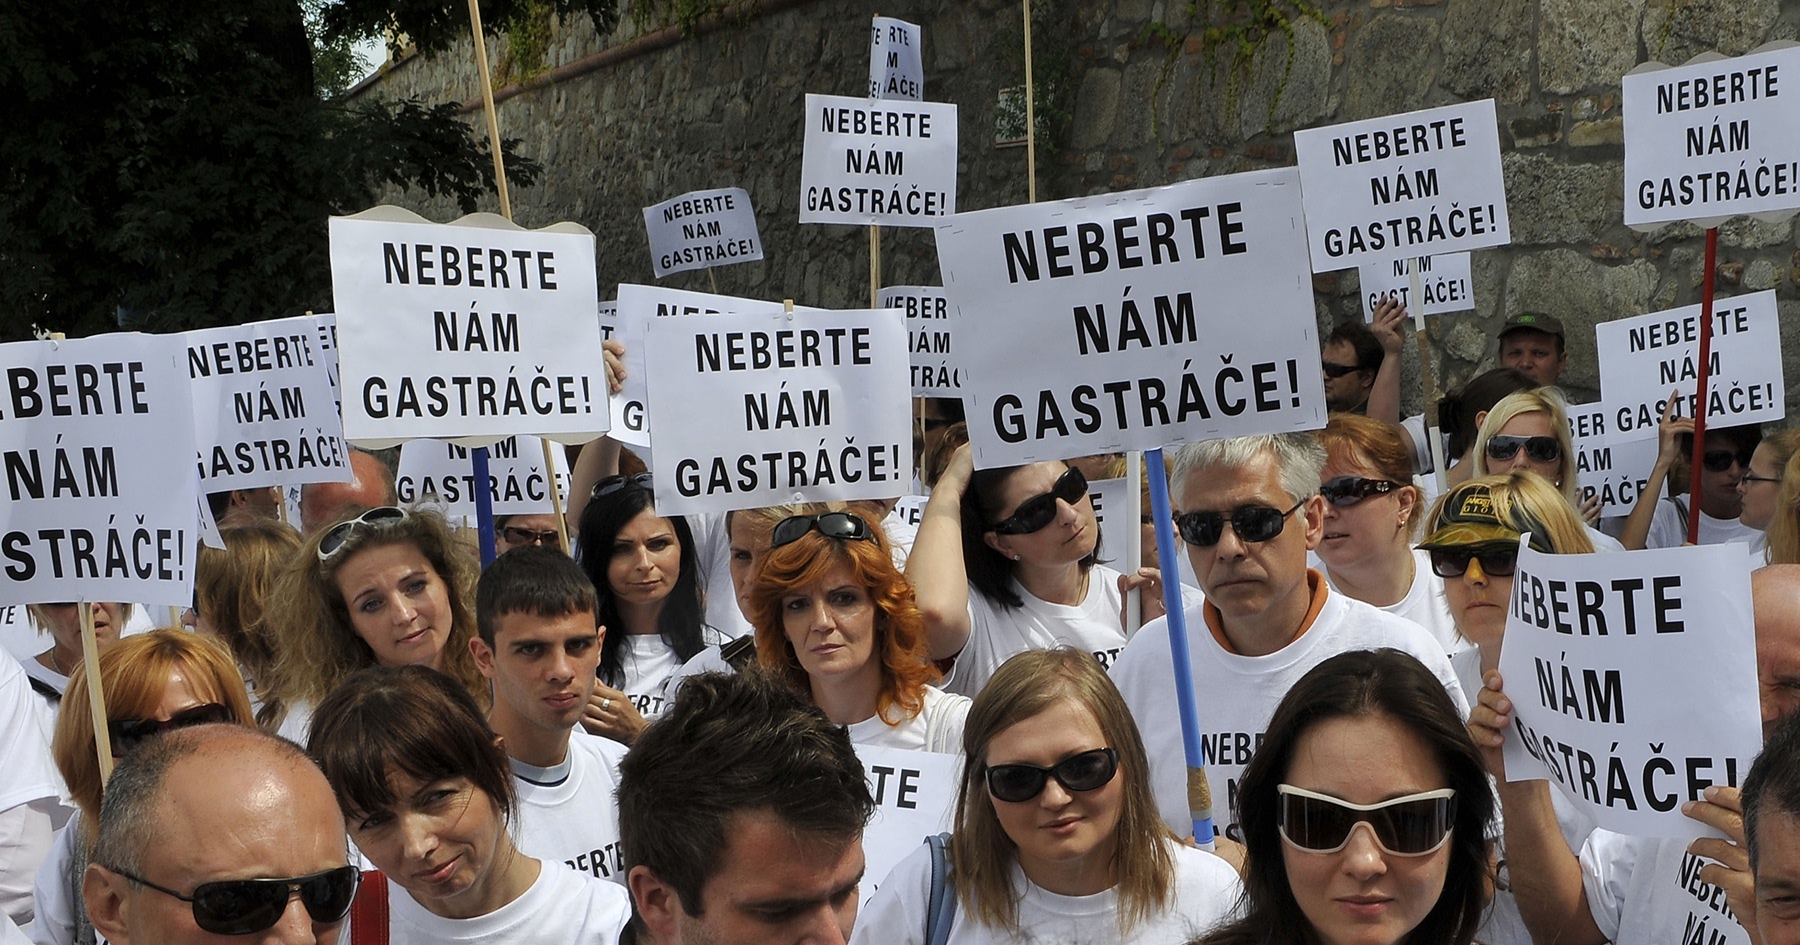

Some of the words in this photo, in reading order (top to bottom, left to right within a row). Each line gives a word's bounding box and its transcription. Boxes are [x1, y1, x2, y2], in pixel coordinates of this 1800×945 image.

[1657, 65, 1778, 114] NEBERTE
[822, 107, 931, 138] NEBERTE
[1332, 117, 1466, 166] NEBERTE
[1686, 115, 1750, 157] NÁM
[846, 143, 903, 176] NÁM
[1638, 157, 1798, 210] GASTRÁČE!
[663, 195, 735, 223] NEBERTE
[807, 183, 946, 216] GASTRÁČE!
[1370, 166, 1439, 205] NÁM
[661, 238, 755, 269] GASTRÁČE!
[682, 219, 721, 240] NÁM
[1002, 202, 1248, 284] NEBERTE
[1324, 202, 1496, 257] GASTRÁČE!
[382, 242, 558, 290] NEBERTE
[1393, 256, 1432, 277] NM
[433, 301, 520, 352] NÁM
[885, 296, 947, 319] NEBER
[1073, 285, 1198, 356] NÁM
[1629, 307, 1749, 353] NEBETE
[187, 335, 314, 379] NEBERTE
[695, 327, 871, 373] NEBERTE
[0, 361, 149, 420] BERTE
[233, 381, 306, 424] NÁM
[362, 365, 592, 418] GASTRÁČE!
[744, 381, 831, 432] NÁM
[993, 353, 1300, 444] GASTRÁČE!
[3, 434, 119, 501] NÁM
[448, 435, 518, 460] NM
[675, 436, 899, 497] GASTRÁČE!
[1576, 444, 1612, 473] ÁM
[1, 514, 185, 581] STRÁČE!
[1510, 566, 1685, 636] NEBERTE
[1534, 651, 1625, 724] NÁM
